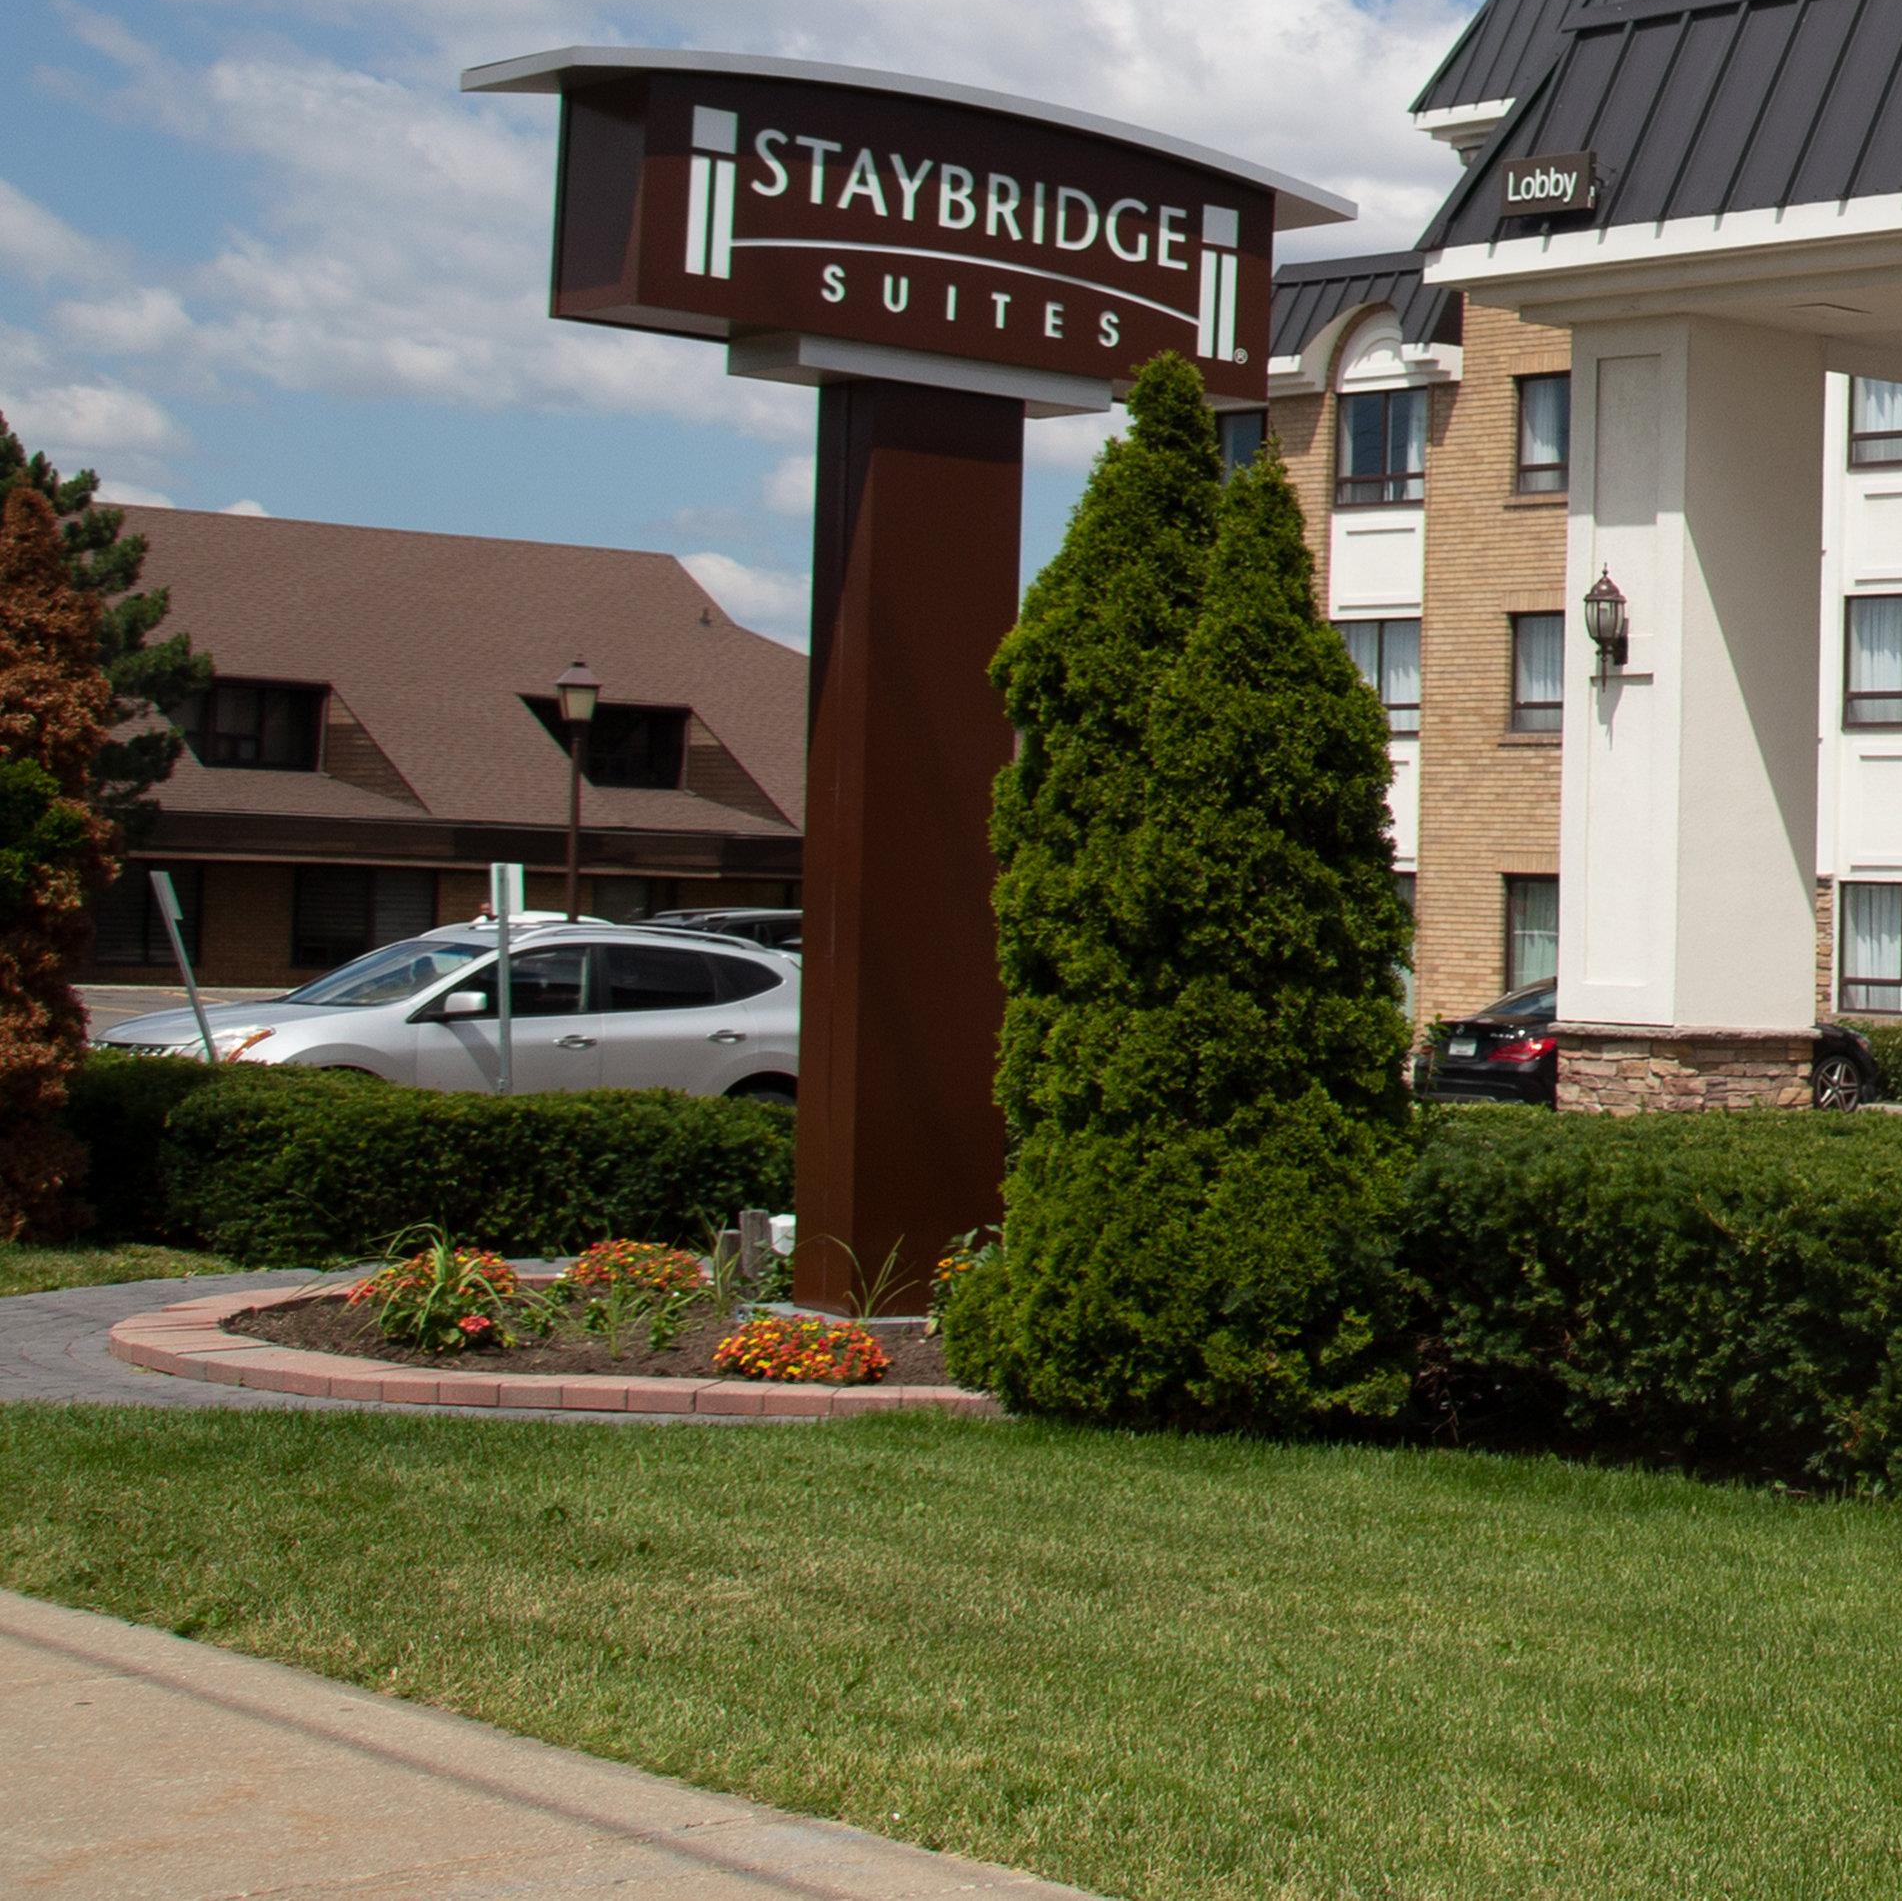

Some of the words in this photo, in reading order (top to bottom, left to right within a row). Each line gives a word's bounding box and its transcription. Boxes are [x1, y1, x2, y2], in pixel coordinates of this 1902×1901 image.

[751, 128, 1190, 271] STAYBRIDGE
[1507, 166, 1577, 203] Lobby
[820, 264, 1121, 348] SUITES
